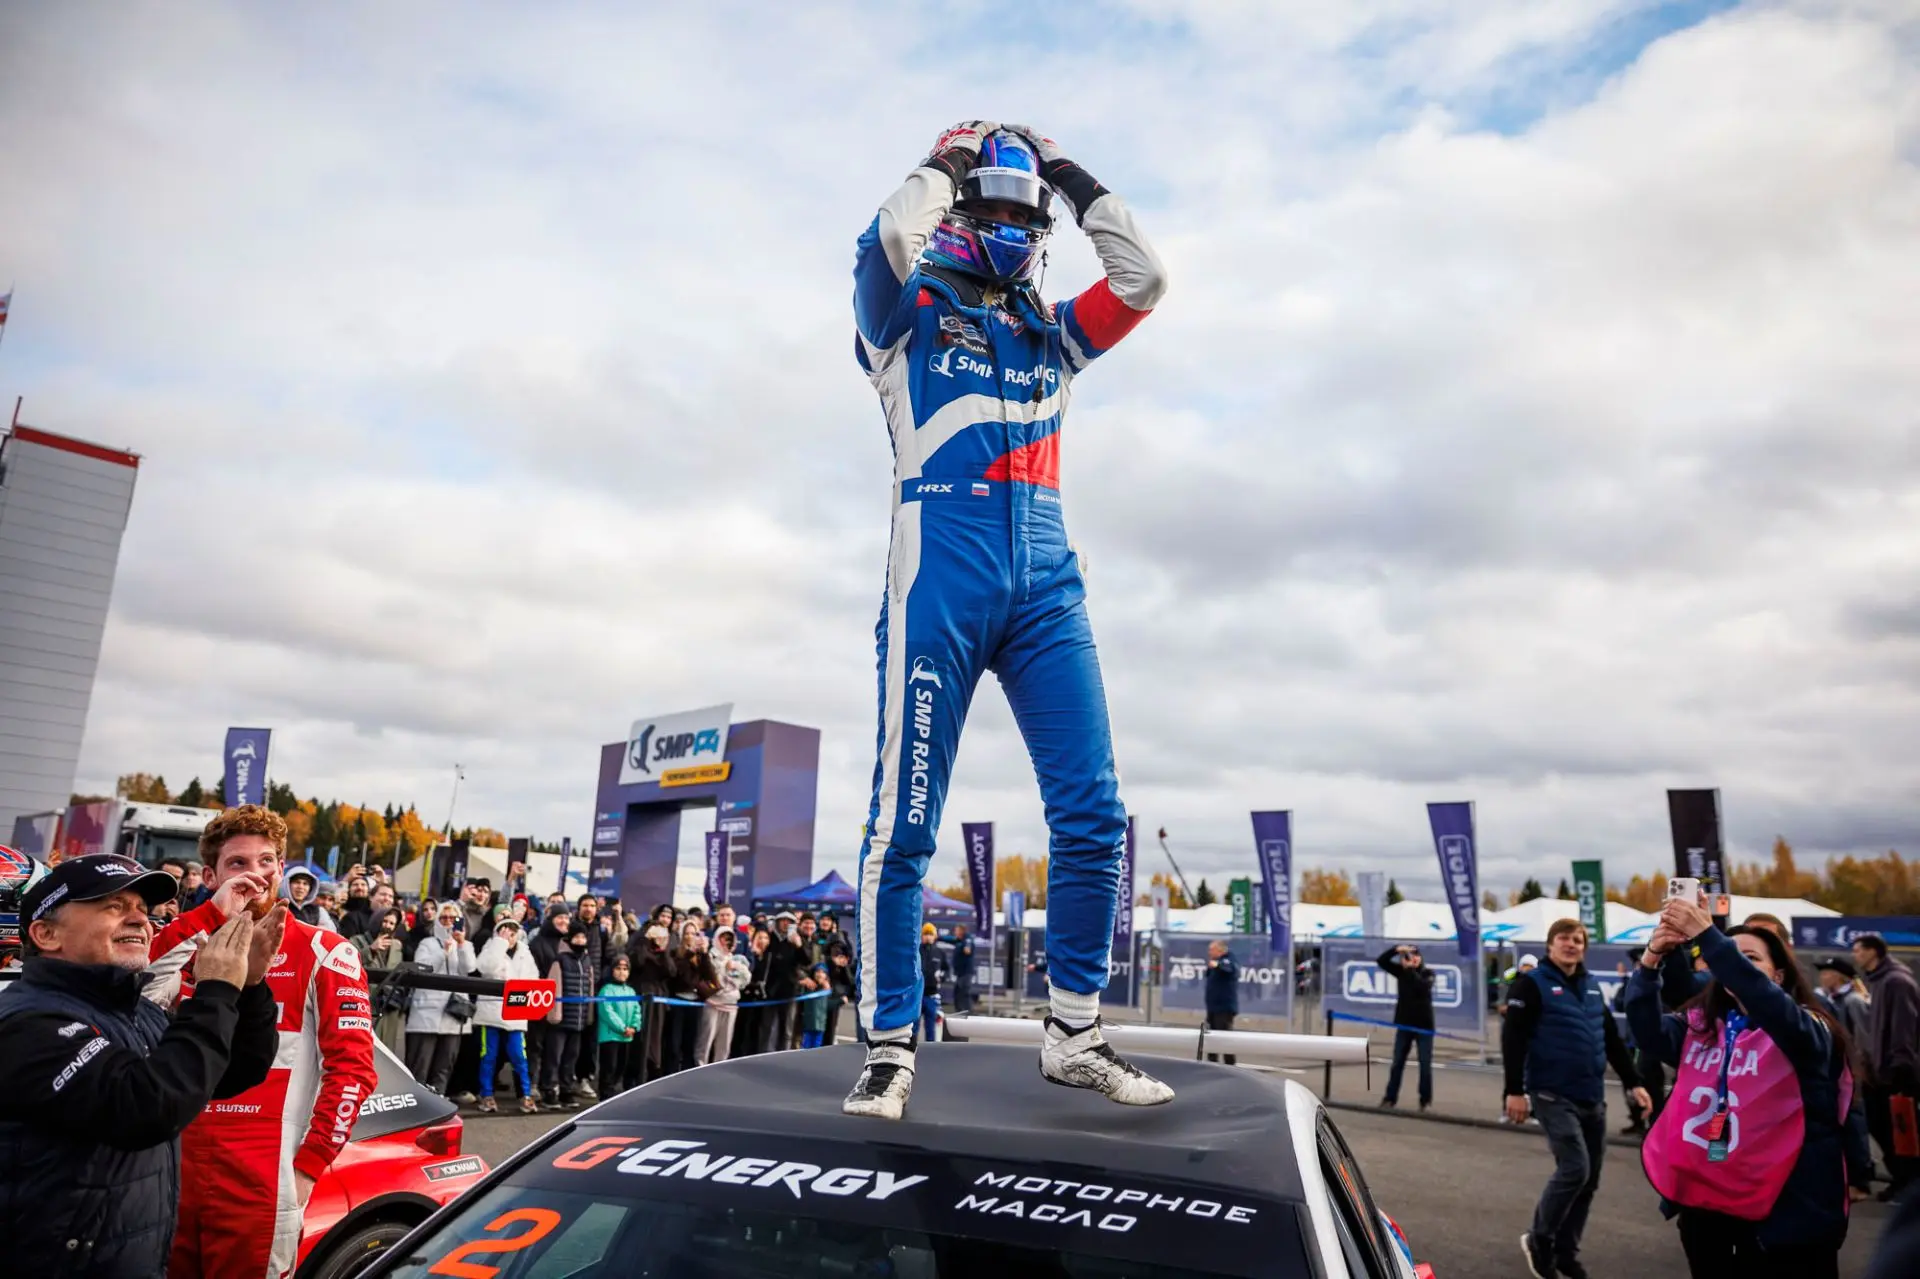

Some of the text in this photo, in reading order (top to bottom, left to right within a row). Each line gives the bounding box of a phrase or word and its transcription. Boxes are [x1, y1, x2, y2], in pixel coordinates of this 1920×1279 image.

[916, 484, 954, 493] HRX
[652, 732, 695, 762] SMP
[908, 688, 932, 825] SMP RACING
[1447, 840, 1478, 925] AIMOL
[1169, 965, 1285, 984] АВТЛОТ
[1349, 970, 1456, 995] AIL
[337, 987, 369, 1000] GENES
[526, 990, 553, 1007] 100
[53, 1037, 110, 1091] GENESIS
[215, 1104, 261, 1113] SLUTSKIY
[332, 1083, 361, 1143] UKOIL
[357, 1094, 417, 1117] ENESIS
[974, 1172, 1257, 1223] МОТОРНОЕ
[428, 1207, 562, 1279] 2
